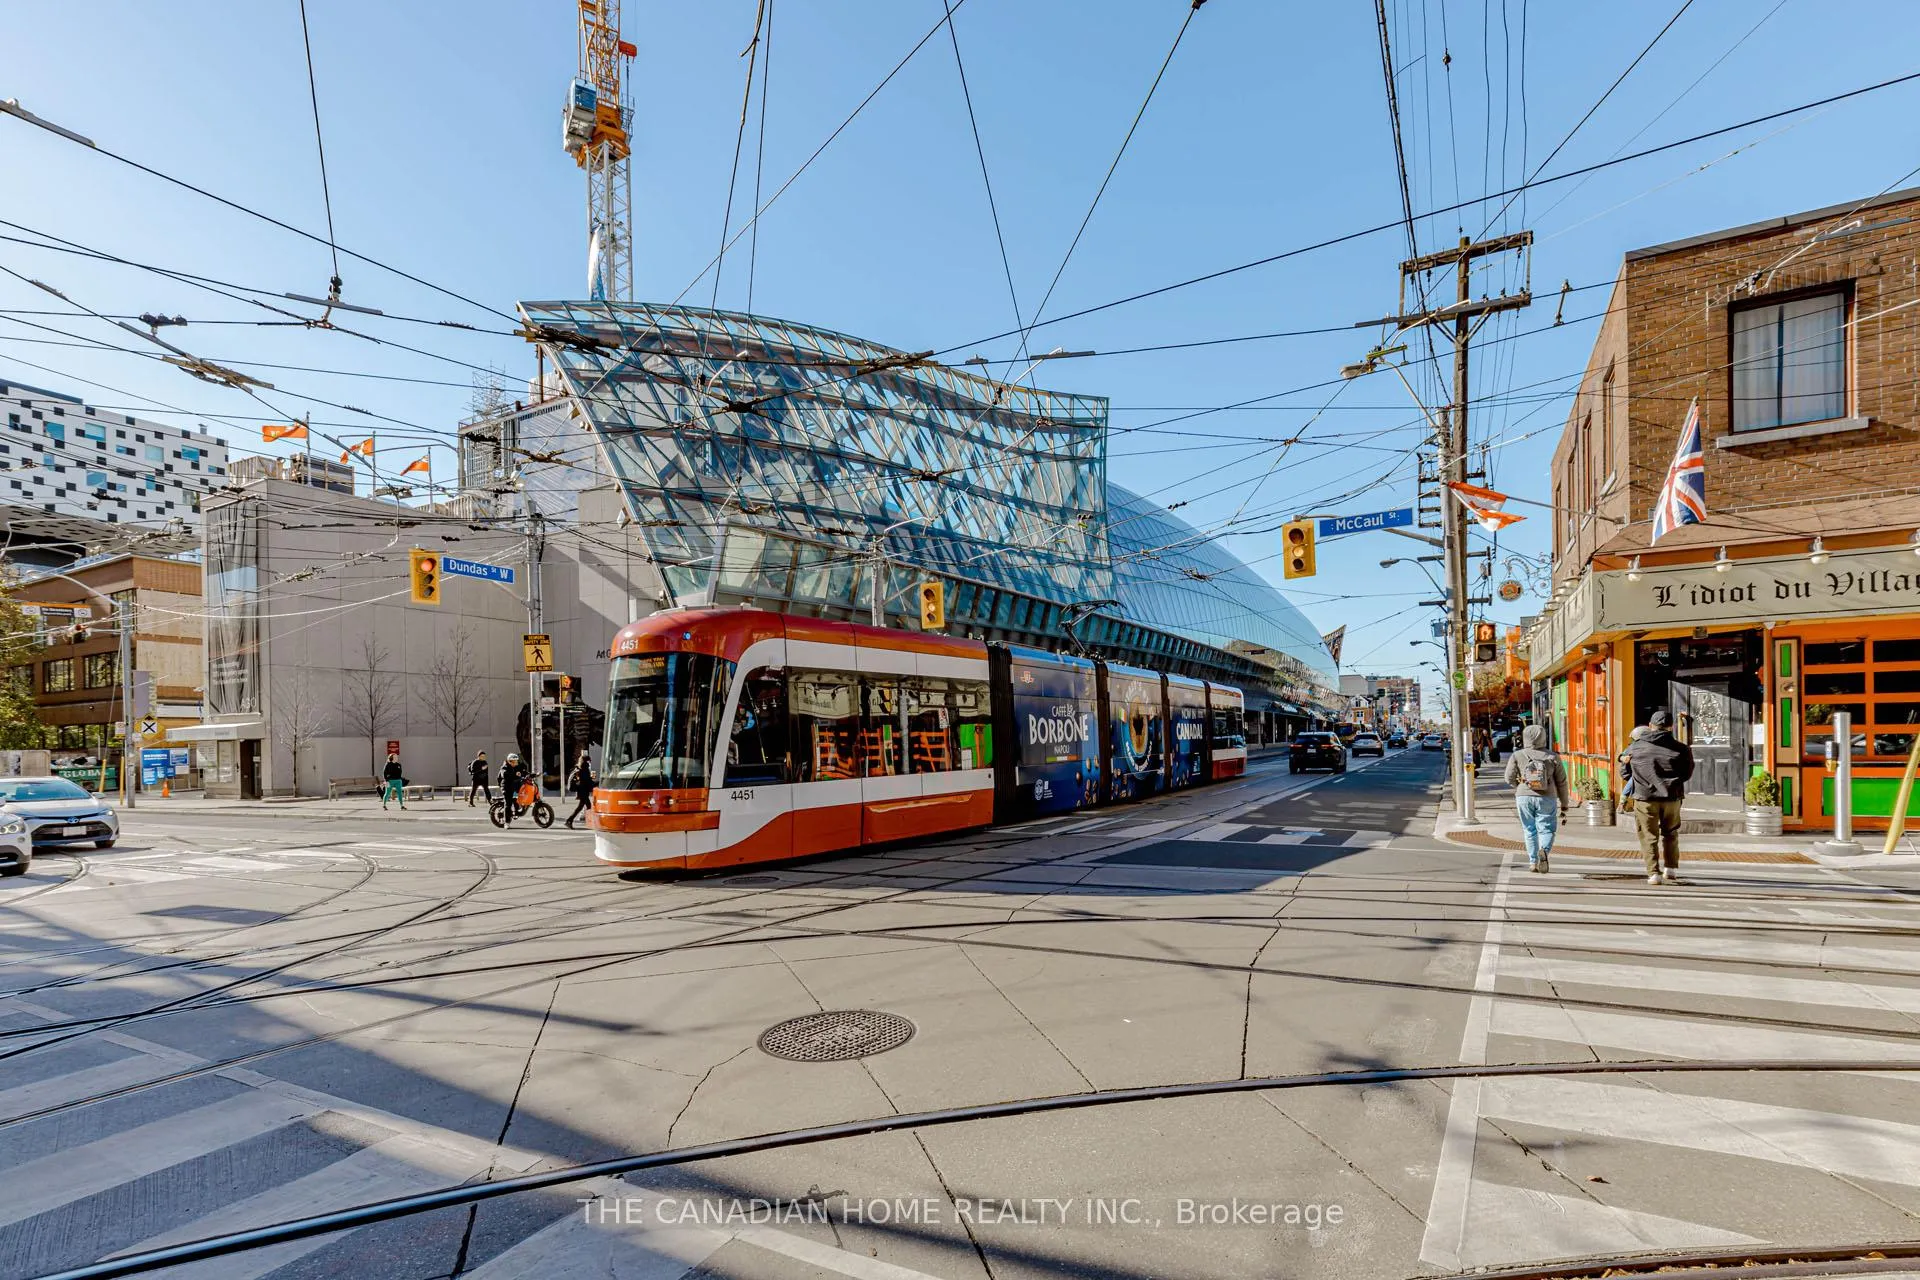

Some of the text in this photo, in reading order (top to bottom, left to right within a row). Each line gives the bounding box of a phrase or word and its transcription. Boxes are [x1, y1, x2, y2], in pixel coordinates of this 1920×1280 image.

[1336, 514, 1384, 531] McCaul
[450, 560, 487, 575] Dundas
[500, 569, 508, 579] W
[1652, 582, 1755, 608] L'idiot
[1774, 579, 1811, 600] du
[621, 640, 638, 650] 4451
[1029, 713, 1089, 744] BORBONE
[1176, 723, 1202, 740] CANADA!
[731, 789, 754, 801] 4451
